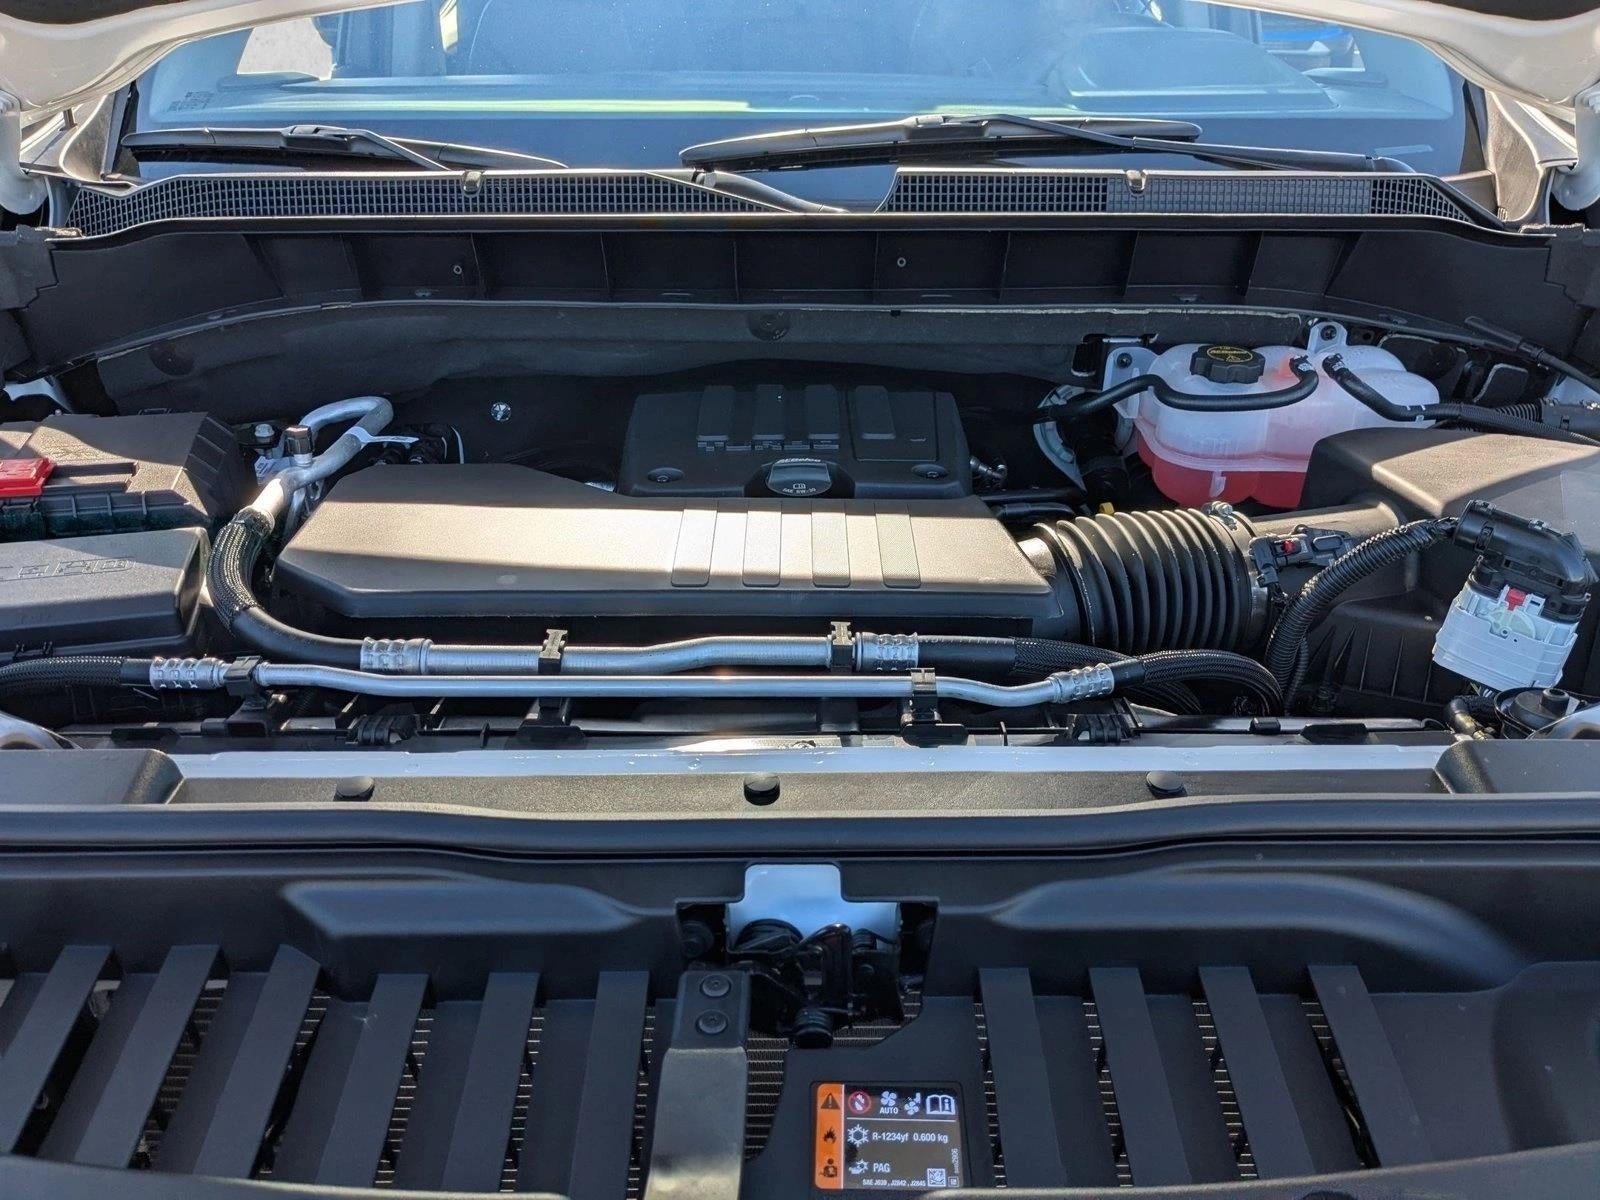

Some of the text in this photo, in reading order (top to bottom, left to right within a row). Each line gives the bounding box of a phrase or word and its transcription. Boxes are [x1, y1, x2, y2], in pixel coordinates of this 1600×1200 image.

[879, 1106, 899, 1115] AUTO
[872, 1132, 949, 1144] R-1234yf 0.600 kg
[873, 1162, 891, 1173] PAG
